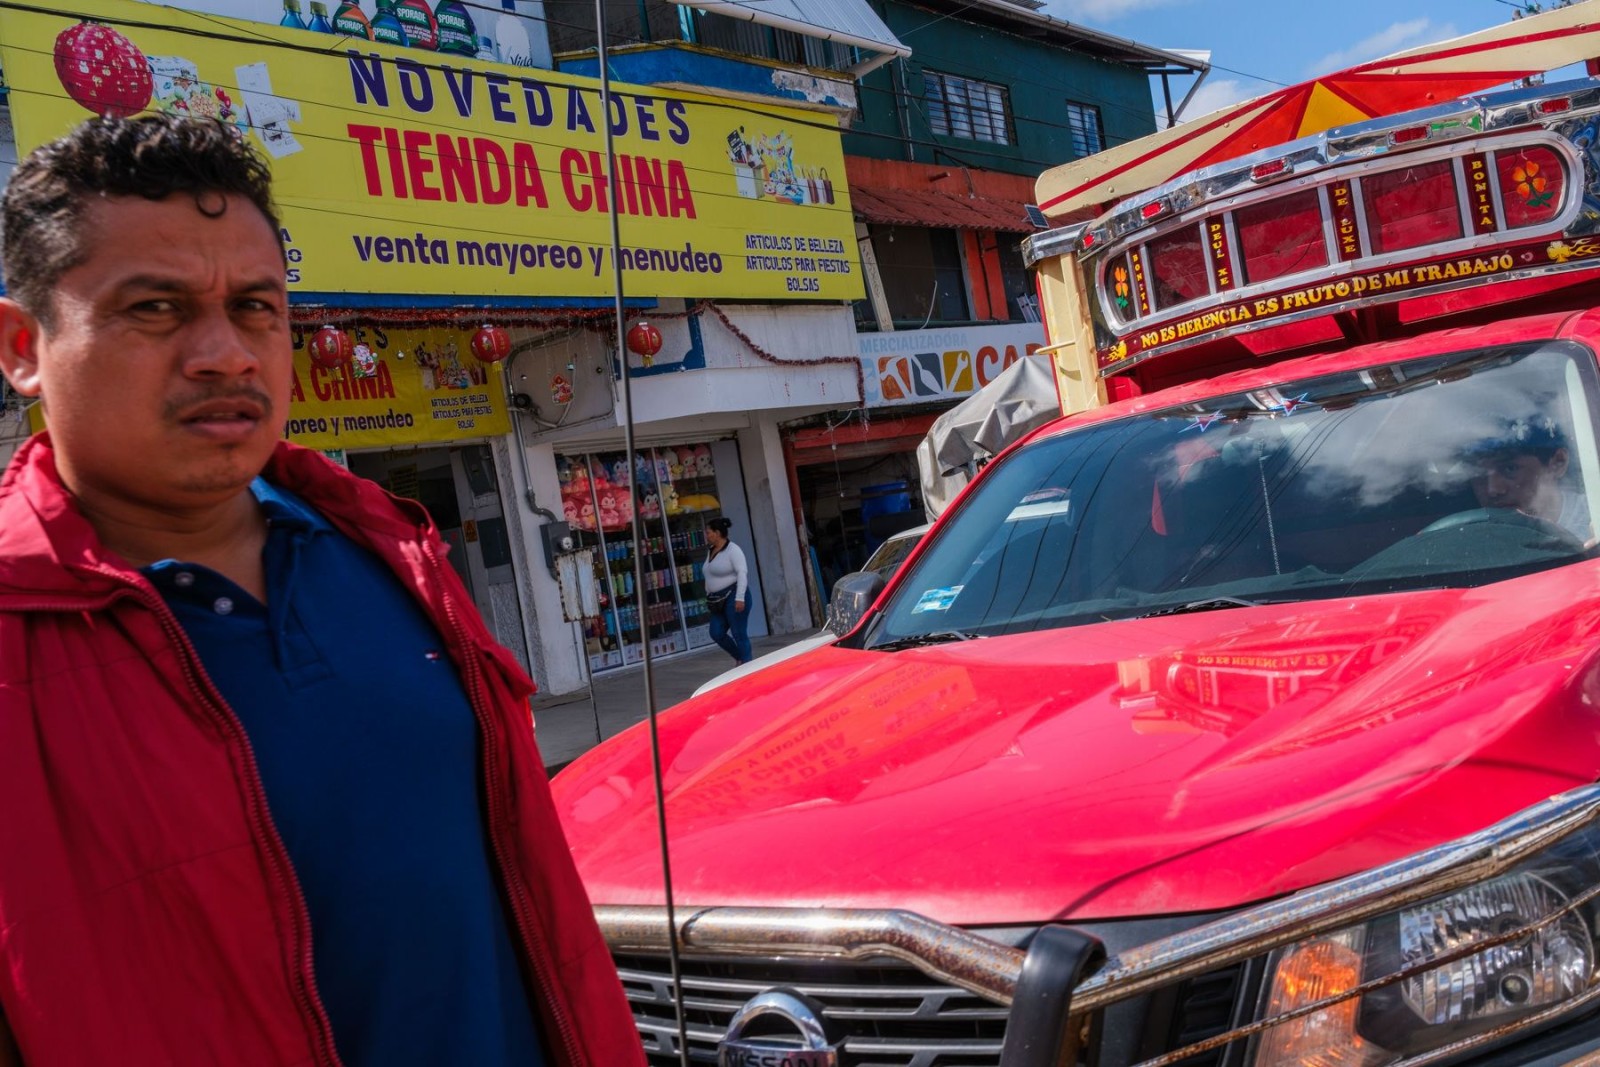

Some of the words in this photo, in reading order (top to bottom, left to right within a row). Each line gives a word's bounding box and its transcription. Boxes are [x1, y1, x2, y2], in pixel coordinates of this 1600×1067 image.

[396, 7, 427, 24] SPORADE
[437, 13, 466, 29] SPORADE
[337, 19, 364, 34] SPORADE
[373, 27, 399, 40] SPORADE
[348, 50, 691, 145] NOVEDADES
[347, 124, 549, 209] TIENDA
[559, 147, 697, 220] CHINA
[1472, 160, 1493, 226] BONITA
[746, 234, 793, 251] ARTICULOS
[795, 237, 806, 251] DE
[808, 238, 845, 254] BELLEZA
[353, 233, 450, 265] venta
[456, 240, 582, 275] mayoreo
[588, 247, 604, 277] y
[611, 242, 723, 275] menudeo
[746, 255, 793, 271] ARTICULOS
[795, 257, 816, 272] PARA
[818, 258, 850, 274] FIESTAS
[786, 277, 820, 292] BOLSAS
[1132, 253, 1149, 311] BONITA
[1141, 333, 1160, 349] NO
[1160, 325, 1176, 342] ES
[1177, 304, 1251, 338] HERENCIA
[1254, 299, 1280, 317] ES
[1283, 280, 1350, 311] FRUTO
[1353, 273, 1382, 293] DE
[1385, 269, 1410, 288] MI
[310, 360, 396, 402] CHINA
[460, 396, 469, 405] DE
[331, 416, 341, 436] y
[344, 408, 415, 432] menudeo
[725, 1052, 817, 1067] NISSAN
